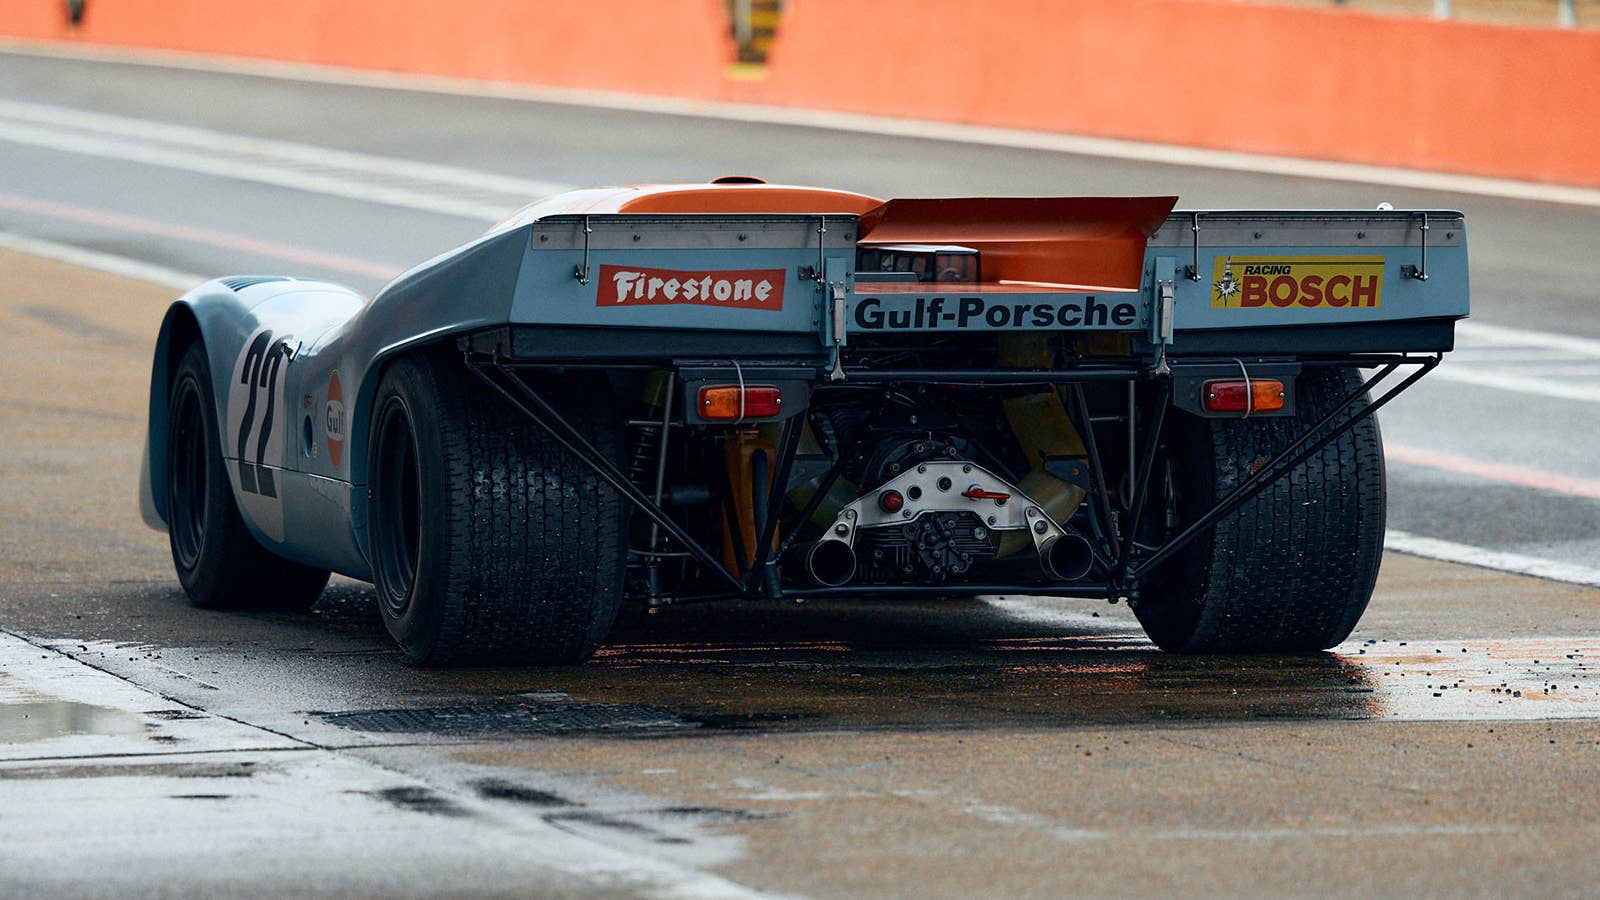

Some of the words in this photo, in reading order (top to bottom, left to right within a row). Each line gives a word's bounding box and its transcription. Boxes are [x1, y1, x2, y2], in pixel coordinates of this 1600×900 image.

[1244, 265, 1291, 275] RACING
[613, 271, 773, 302] Firestone
[1240, 275, 1378, 308] BOSCH
[854, 296, 1137, 329] Gulf-Porsche
[238, 329, 291, 499] 22
[327, 405, 345, 435] Gulf
